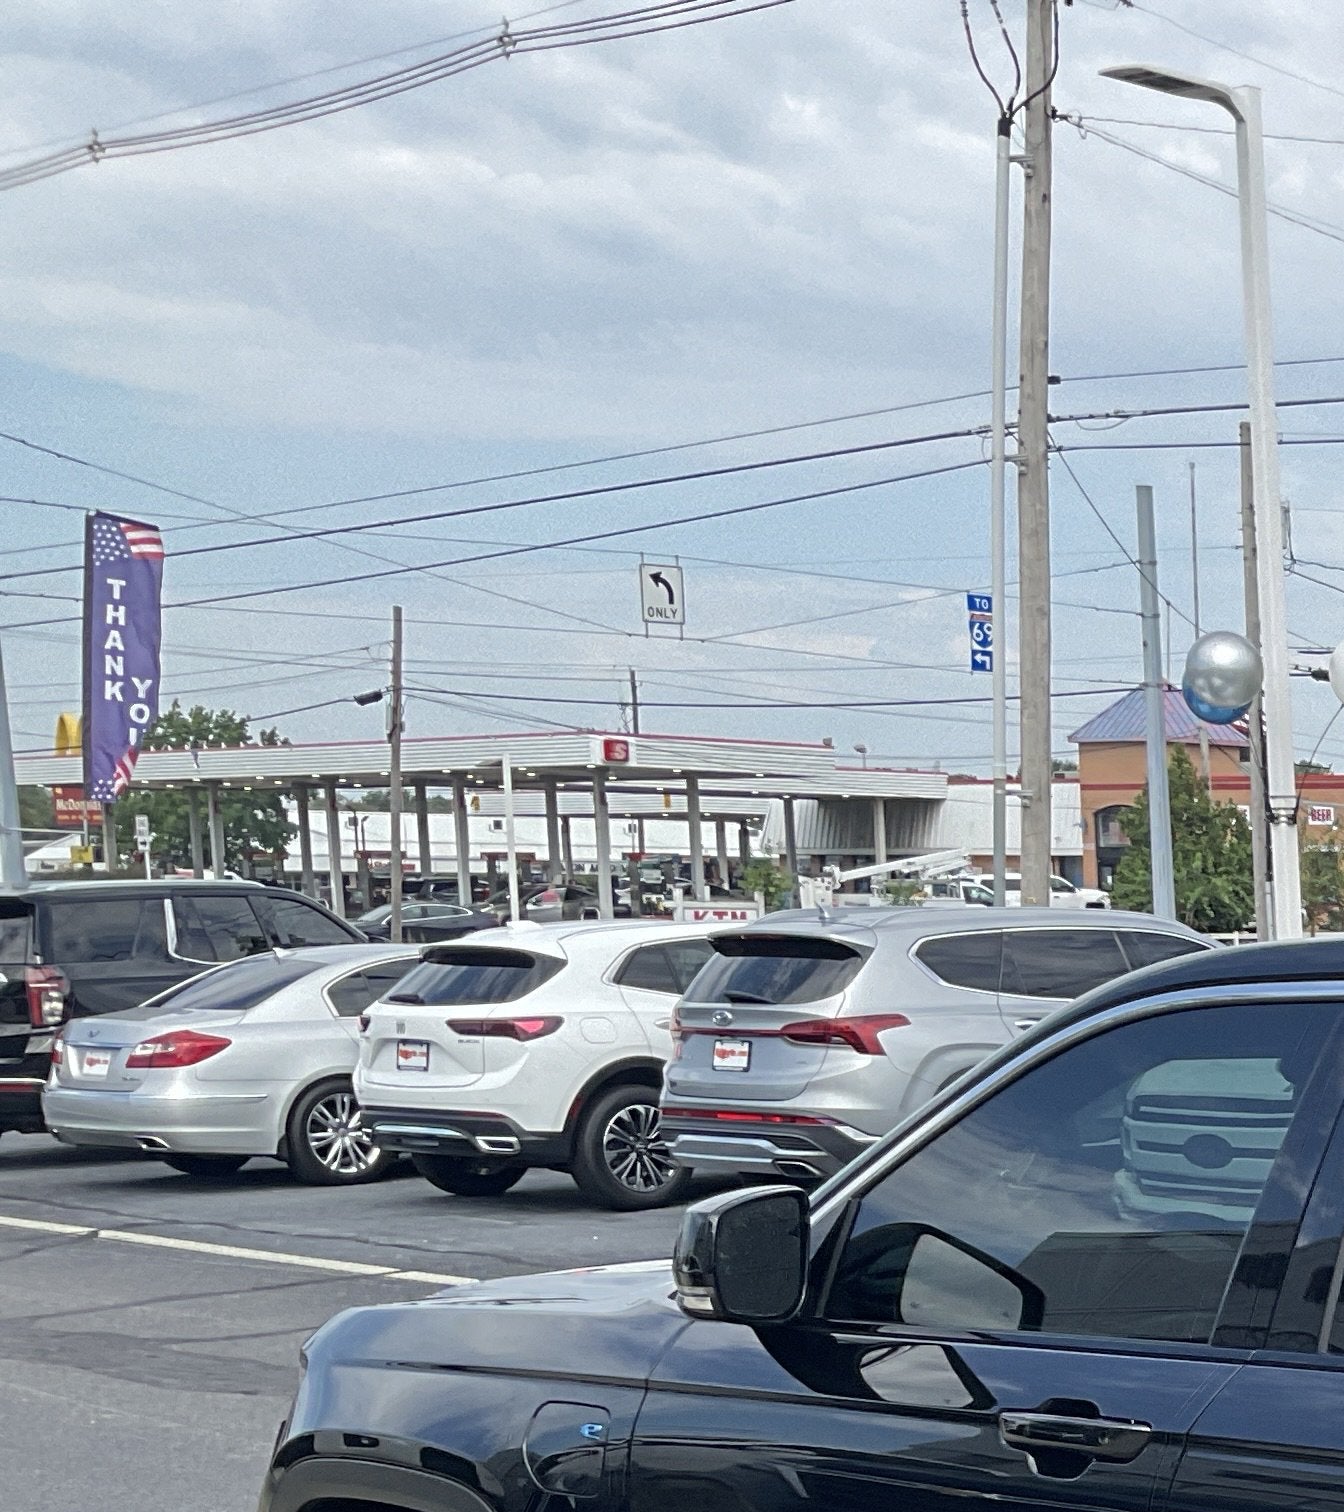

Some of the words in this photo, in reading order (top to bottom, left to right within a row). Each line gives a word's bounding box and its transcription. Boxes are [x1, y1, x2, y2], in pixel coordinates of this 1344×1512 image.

[974, 597, 989, 610] TO
[647, 606, 678, 619] ONLY
[972, 622, 993, 642] 69
[104, 577, 127, 702] THANK
[1311, 808, 1332, 822] BEER
